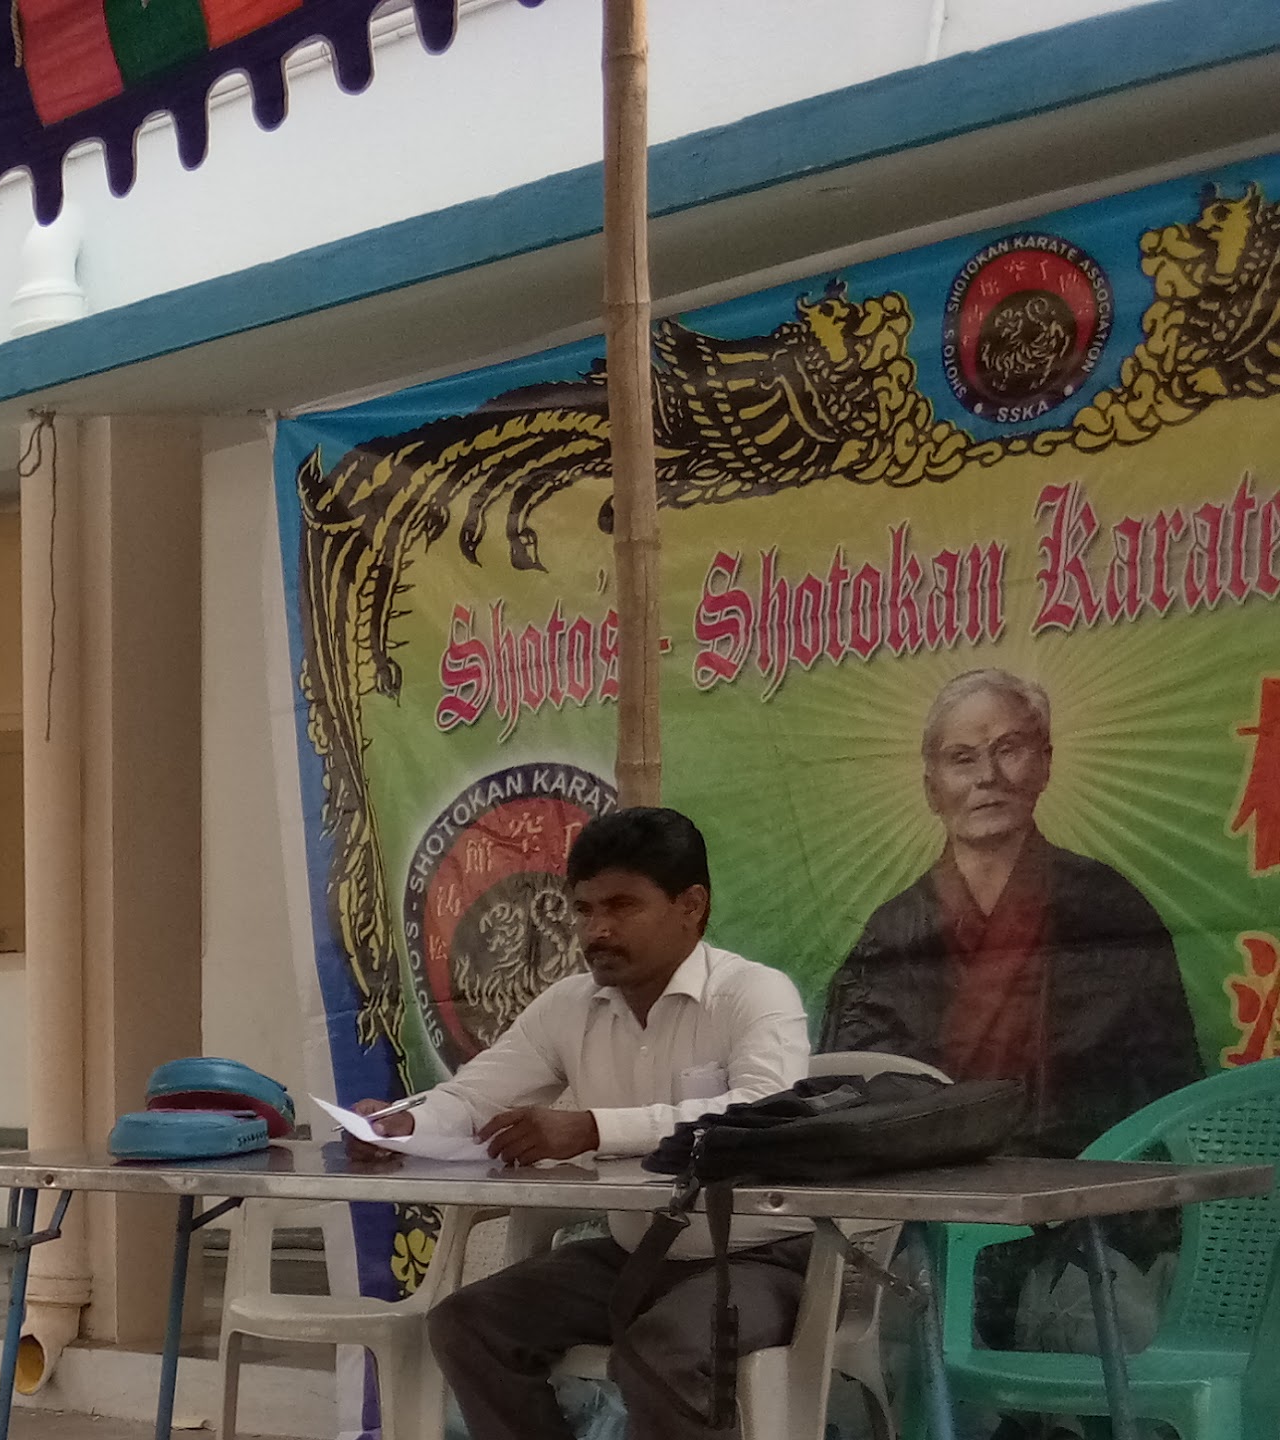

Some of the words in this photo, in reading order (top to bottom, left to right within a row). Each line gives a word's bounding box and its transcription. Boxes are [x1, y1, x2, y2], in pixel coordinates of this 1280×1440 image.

[947, 240, 1009, 313] SHOTOKAN
[1013, 235, 1077, 260] KARATE
[1078, 259, 1112, 373] ASSOCIATION
[996, 400, 1049, 423] SSKA
[692, 518, 1007, 703] Shotokan
[409, 772, 523, 894] SHOTOKAN
[532, 768, 622, 817] KARAT
